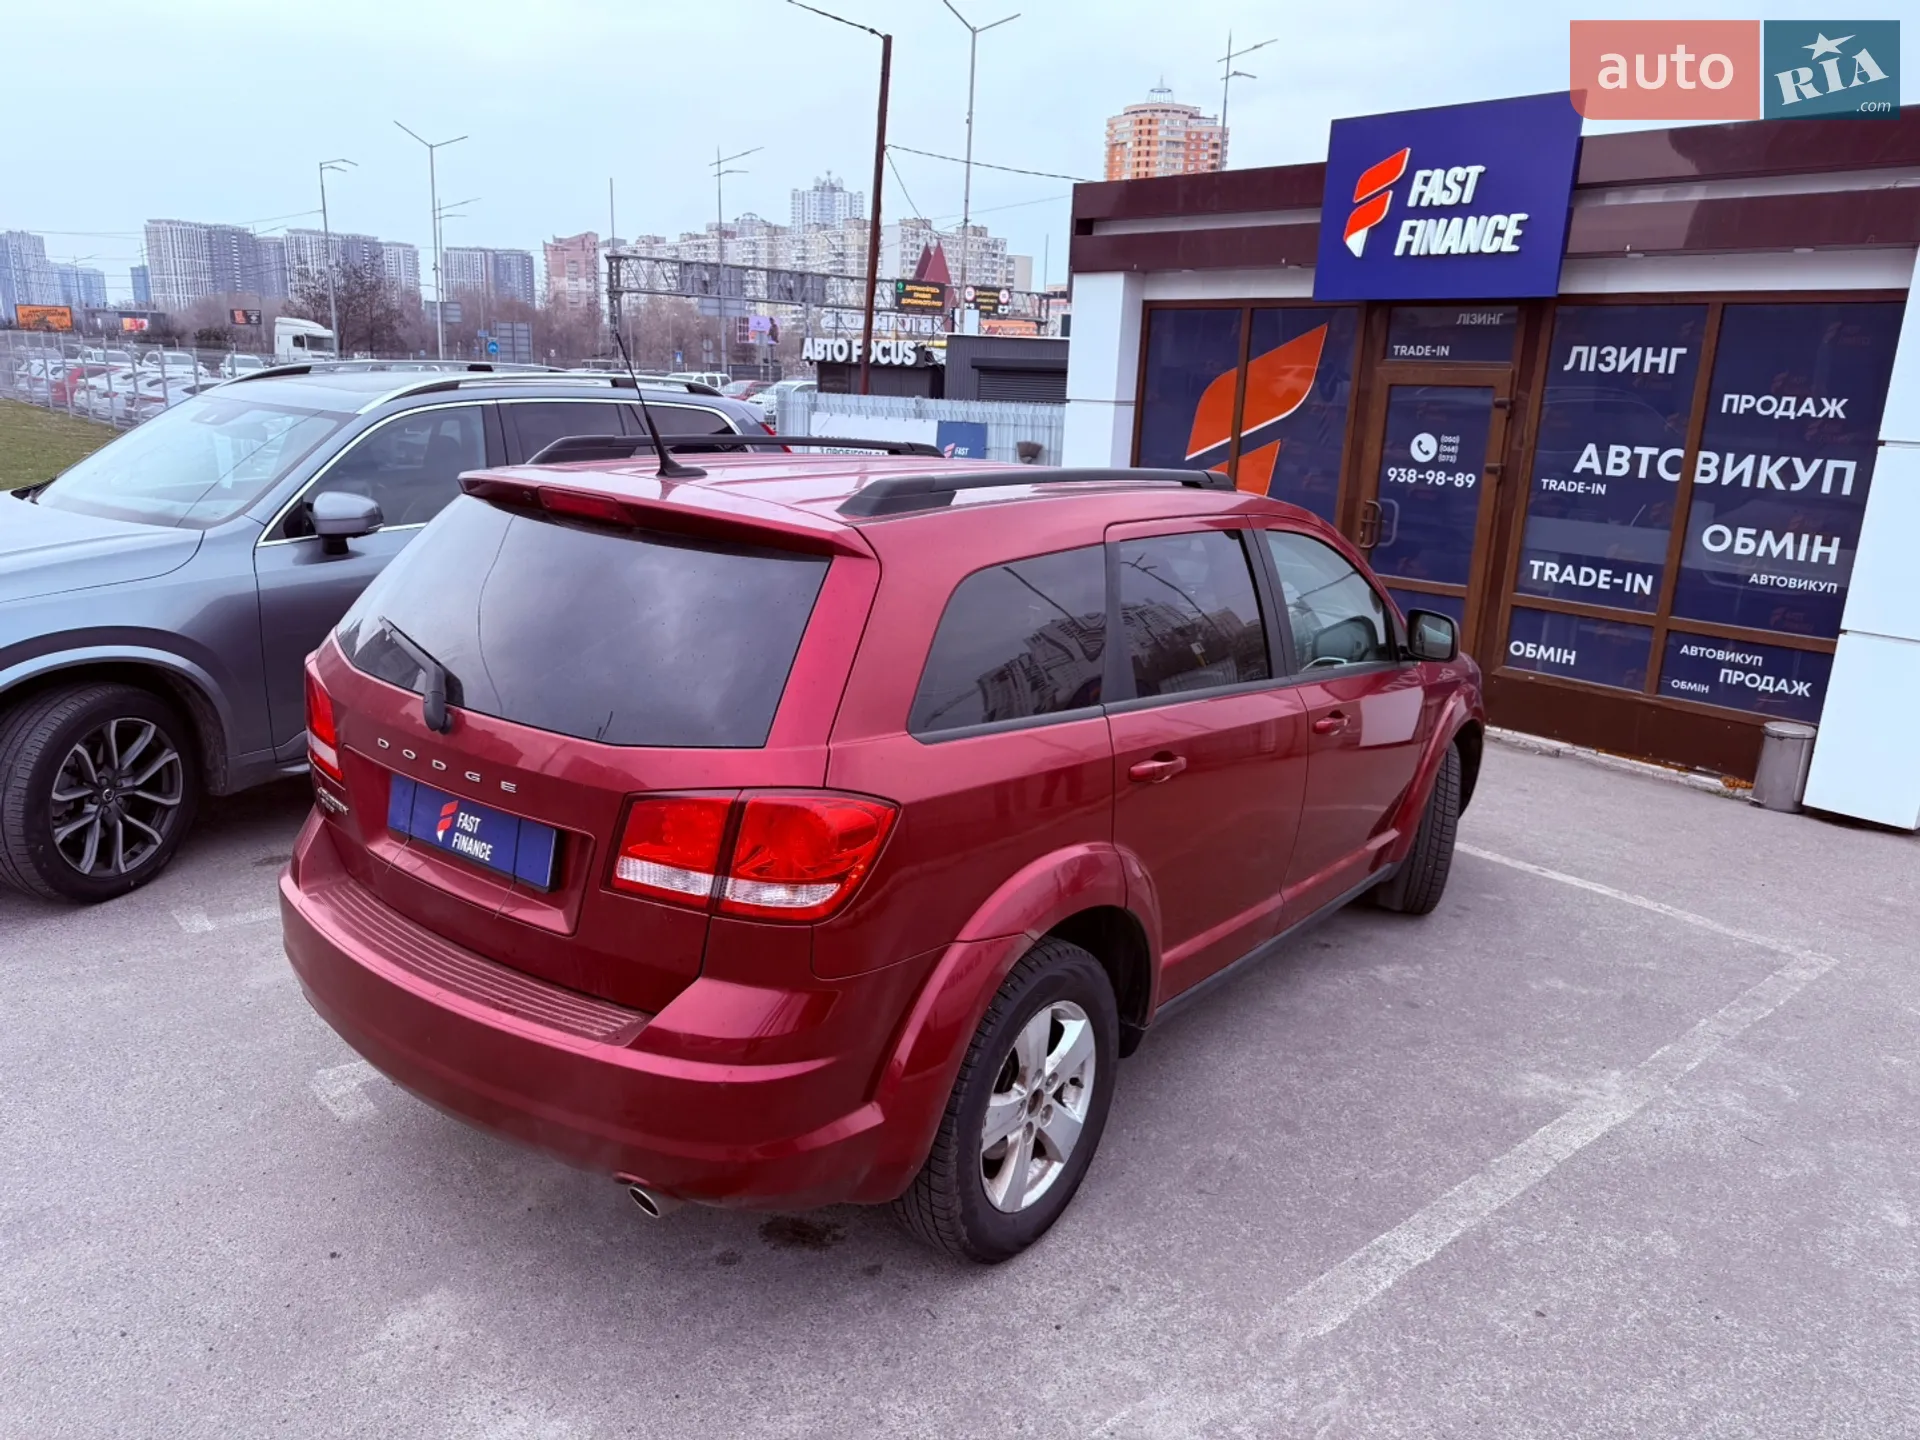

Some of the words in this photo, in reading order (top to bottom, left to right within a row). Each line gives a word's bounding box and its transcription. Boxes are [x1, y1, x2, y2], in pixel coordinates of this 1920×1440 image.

[1407, 165, 1487, 207] FAST
[1393, 213, 1530, 257] FINANCE
[1456, 313, 1504, 326] ЛІЗИНГ
[1393, 345, 1450, 357] TRADE-IN
[1563, 345, 1688, 375] ЛІЗИНГ
[1721, 393, 1849, 420] ПРОДАЖ
[1387, 467, 1476, 488] 938-98-89
[1573, 442, 1857, 496] АВТОВИКУП
[1541, 478, 1607, 495] TRADE-IN
[1701, 524, 1841, 565] ОБМІН
[1528, 559, 1654, 596] TRADE-IN
[1748, 572, 1838, 594] АВТОВИКУП
[1508, 640, 1577, 666] ОБМІН
[1679, 644, 1764, 667] АВТОВИКУП
[1671, 678, 1710, 694] ОБМІН
[1718, 667, 1812, 698] ПРОДАЖ
[377, 737, 517, 794] DODGE
[456, 811, 482, 835] FAST
[451, 832, 494, 862] FINANCE
